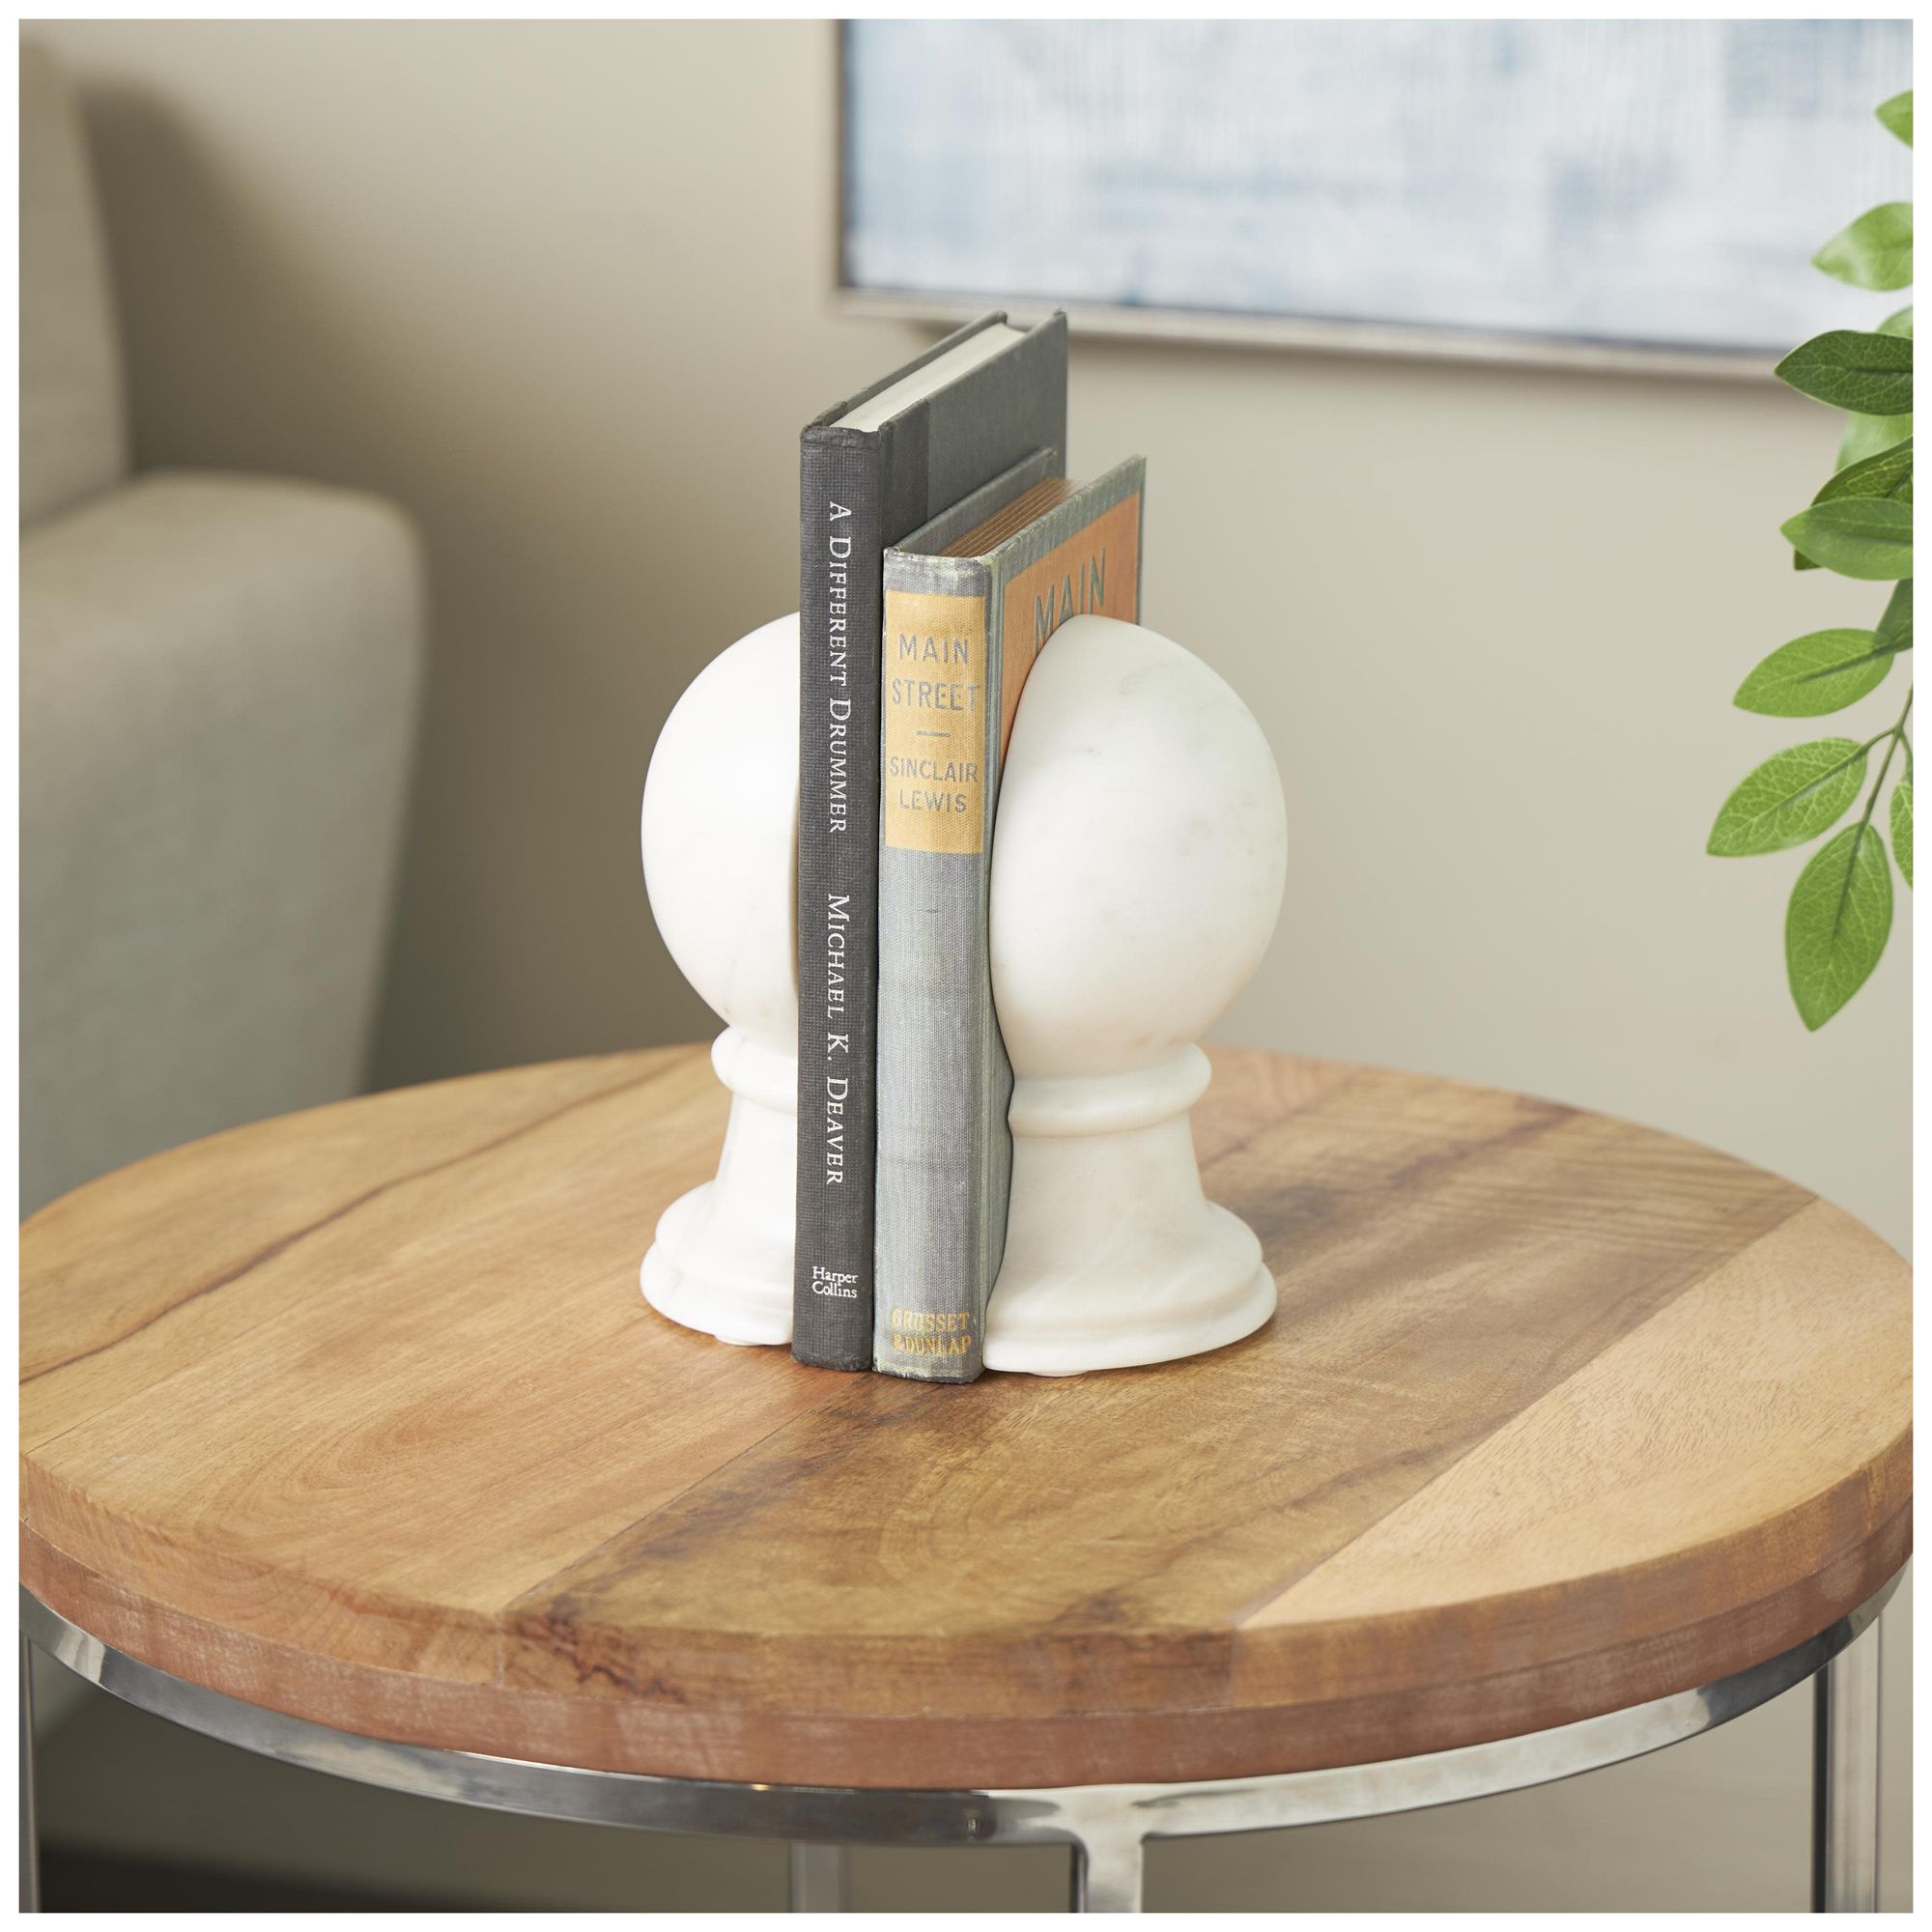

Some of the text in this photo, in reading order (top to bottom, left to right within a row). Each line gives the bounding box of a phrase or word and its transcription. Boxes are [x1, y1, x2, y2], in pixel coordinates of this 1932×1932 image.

[1034, 548, 1106, 657] MAIN
[898, 633, 970, 665] MAIN
[829, 500, 852, 834] A DIFFERENT DRUMMER
[892, 678, 980, 712] STREET
[889, 755, 979, 783] SINCLAIR
[899, 787, 967, 813] LEWIS
[826, 893, 851, 1186] MICHAEL K. DEAVER
[811, 1265, 859, 1287] Harper
[811, 1280, 858, 1298] Collins
[892, 1307, 971, 1333] GROSSET
